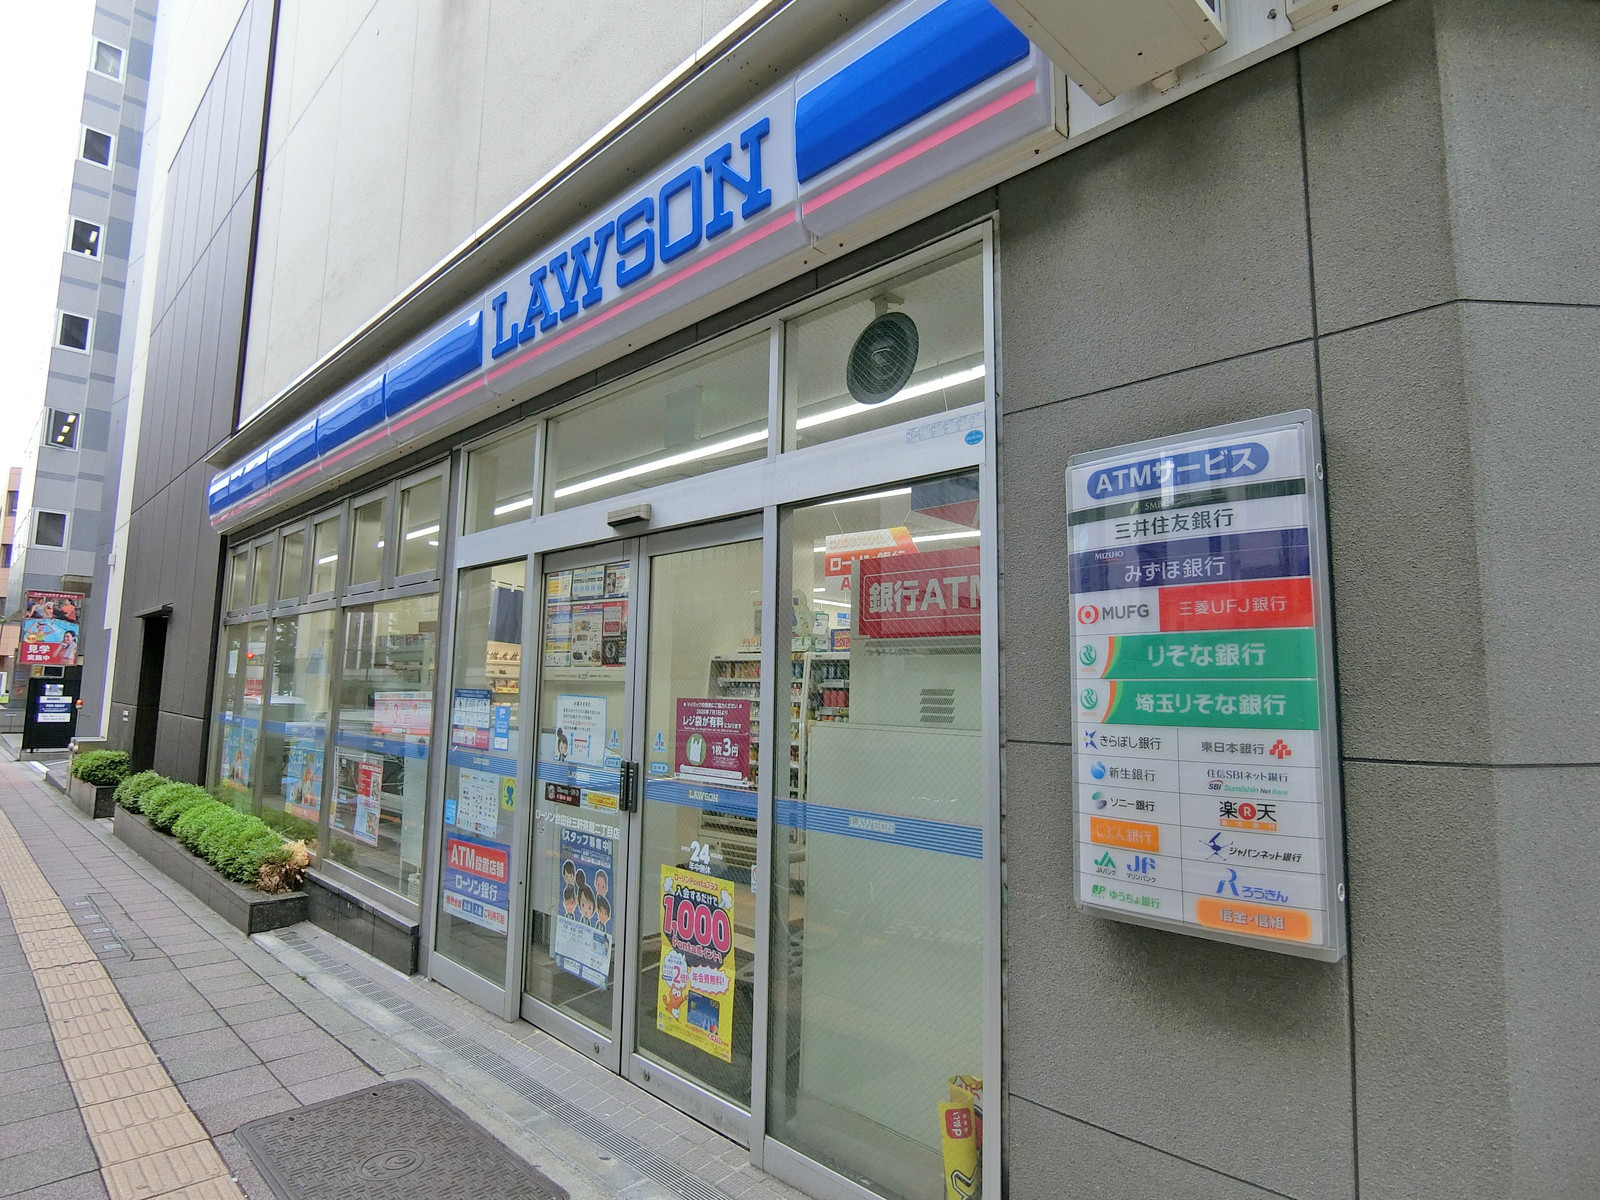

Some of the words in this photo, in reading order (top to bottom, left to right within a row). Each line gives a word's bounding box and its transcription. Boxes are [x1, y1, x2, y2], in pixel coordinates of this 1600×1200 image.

[491, 116, 772, 360] LAWSON
[1095, 447, 1257, 495] ATMサービス
[1114, 508, 1235, 540] 三井住友銀行
[1094, 550, 1124, 561] MIZUHO
[1125, 556, 1226, 583] みずほ銀行
[1102, 603, 1150, 621] MUFG
[1179, 596, 1288, 616] 三菱UFJ銀行
[27, 644, 51, 654] 見学
[1148, 643, 1266, 667] りそな銀行
[1136, 693, 1287, 716] 埼玉りそな銀行
[1100, 735, 1162, 751] きらぼし銀行
[1201, 741, 1265, 755] 東日本銀行
[1109, 766, 1156, 782] 新生銀行
[1207, 768, 1288, 782] 住信SBIネット銀行
[688, 790, 719, 803] LAWSON
[1208, 783, 1222, 791] SBI
[1224, 784, 1259, 793] Sumishin
[1272, 788, 1289, 796] Bank
[1110, 797, 1156, 812] ソニー銀行
[848, 816, 895, 834] LAWSON
[1096, 824, 1152, 845] じぶん銀行
[450, 844, 504, 879] ATM設置店舗
[690, 840, 711, 865] 24
[1228, 846, 1302, 863] ジャパンネット銀行
[1095, 867, 1116, 876] JAバンク
[1126, 872, 1156, 883] マリンバンク
[455, 874, 498, 902] ローソン銀行
[674, 873, 719, 892] ローソンPontaプラス
[676, 885, 719, 908] 入会するだけで
[1109, 890, 1160, 909] ゆうちょ銀行
[1241, 885, 1289, 903] ろうきん
[664, 894, 732, 953] 1,000
[1220, 908, 1286, 931] 信金・信組
